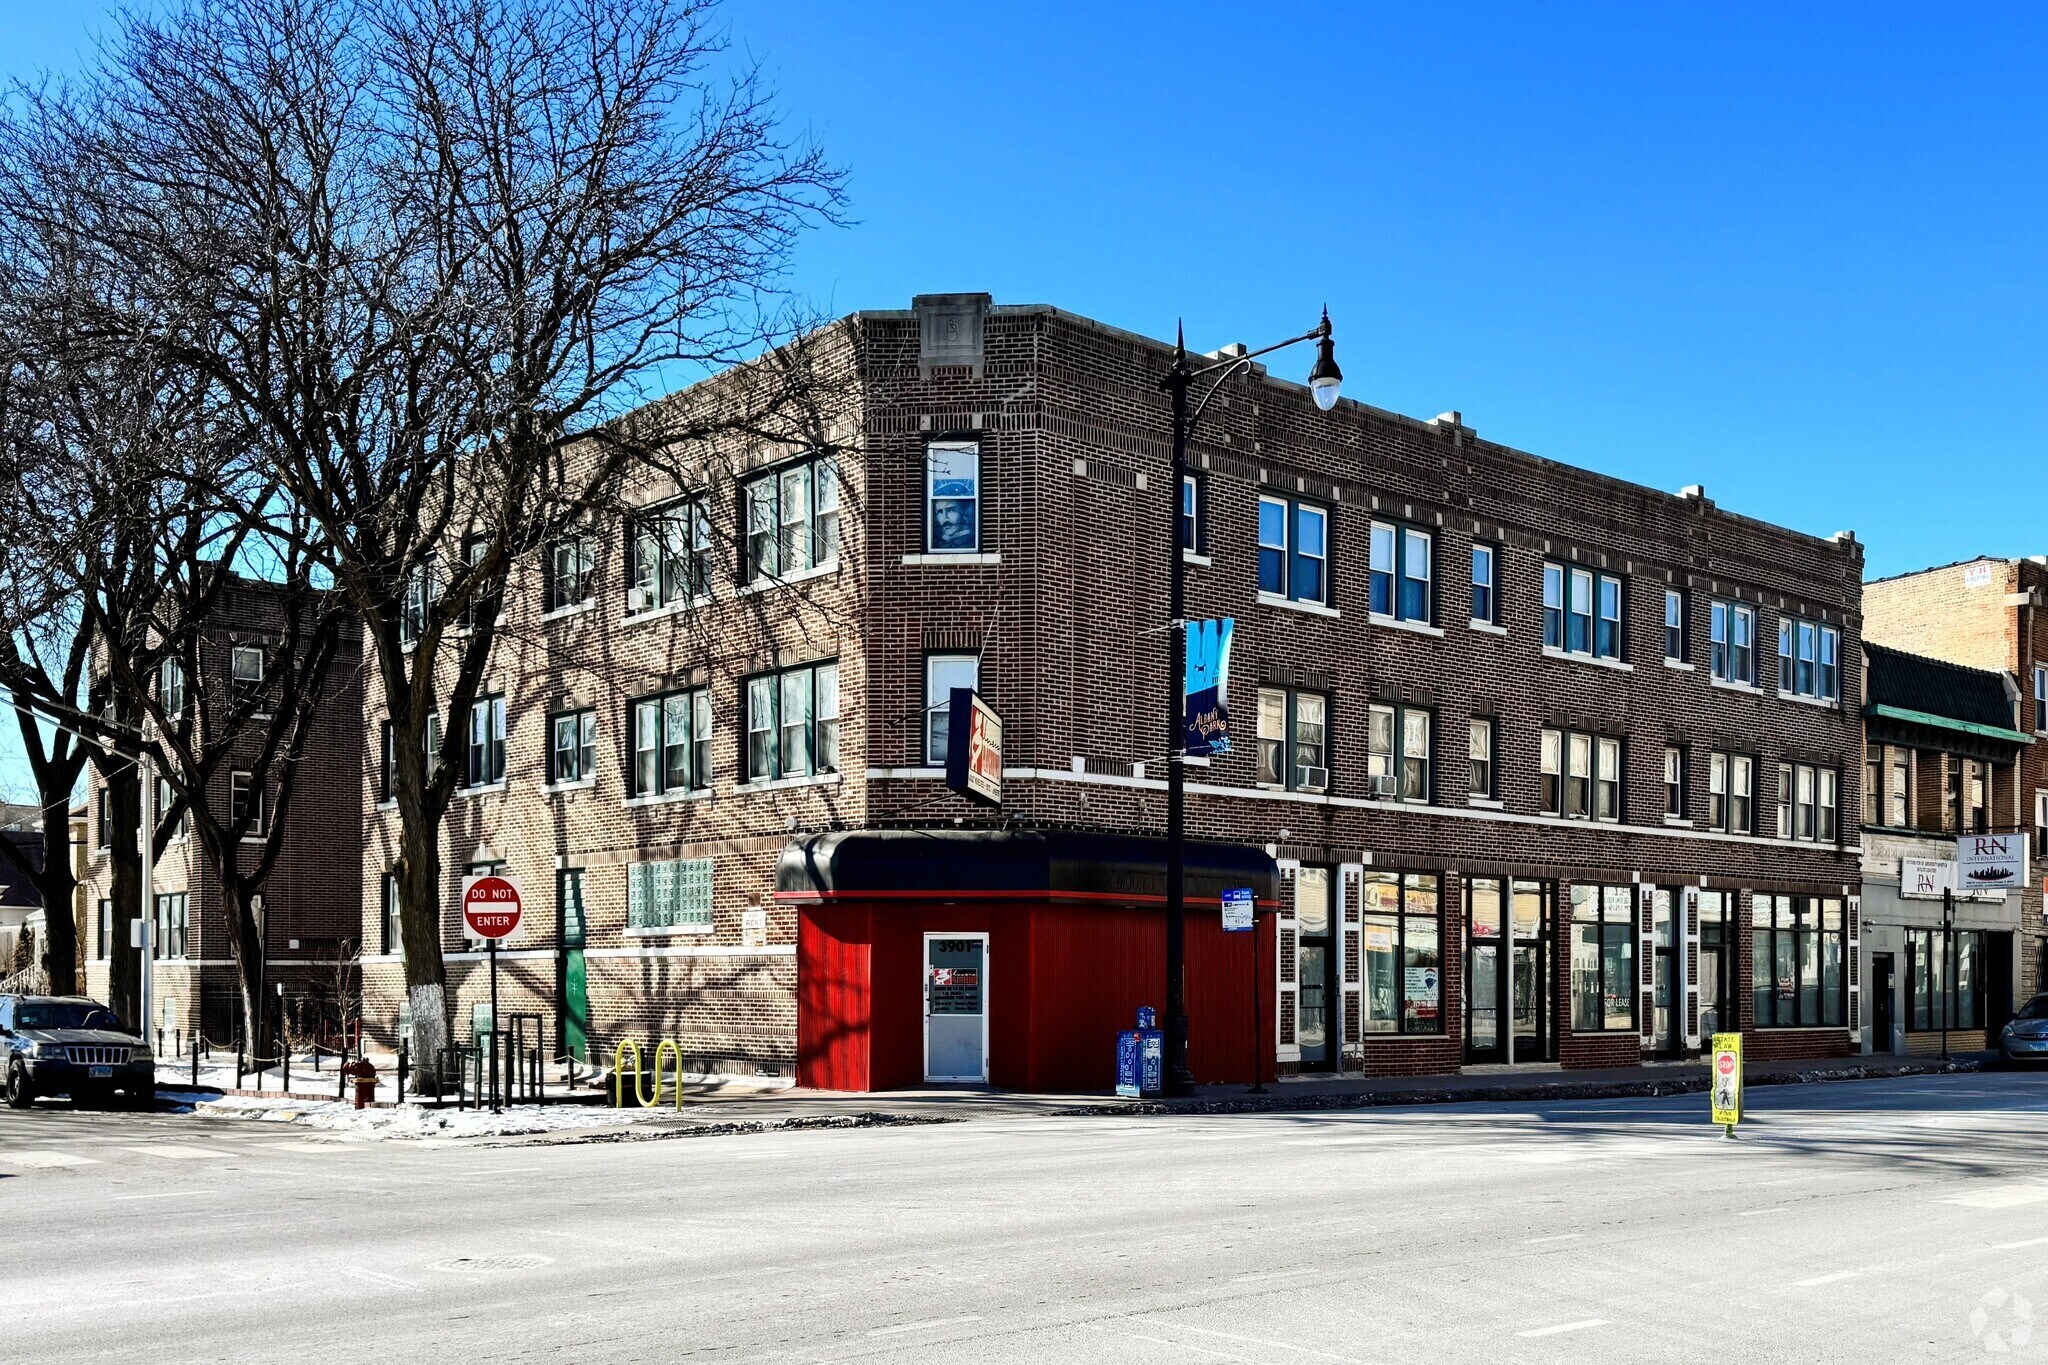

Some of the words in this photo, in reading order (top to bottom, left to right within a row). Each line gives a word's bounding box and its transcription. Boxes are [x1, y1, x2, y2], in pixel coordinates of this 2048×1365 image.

[1189, 707, 1219, 731] ALBANY
[1201, 720, 1227, 740] PARK
[1975, 837, 2007, 855] RN
[1917, 874, 1934, 892] RN
[472, 889, 486, 898] DO
[492, 889, 512, 898] NOT
[477, 916, 509, 926] ENTER
[939, 940, 972, 952] 3901
[1615, 998, 1630, 1007] LEASE
[1718, 1061, 1734, 1069] STOP
